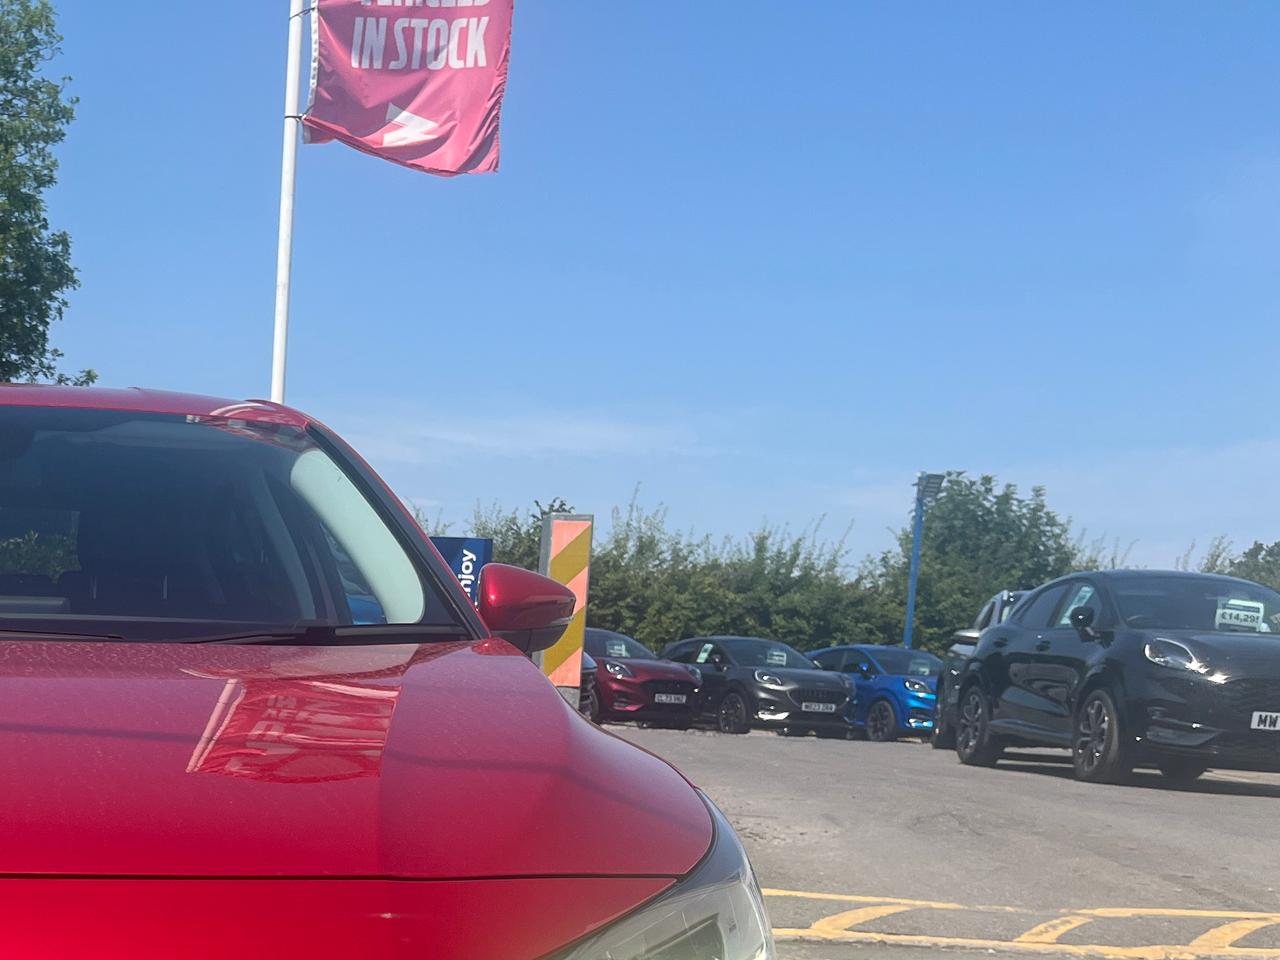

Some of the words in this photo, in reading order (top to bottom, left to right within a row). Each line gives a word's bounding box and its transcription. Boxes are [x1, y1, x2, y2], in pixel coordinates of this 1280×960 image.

[351, 17, 387, 69] IN
[389, 16, 489, 70] STOCK
[458, 549, 476, 597] njoy
